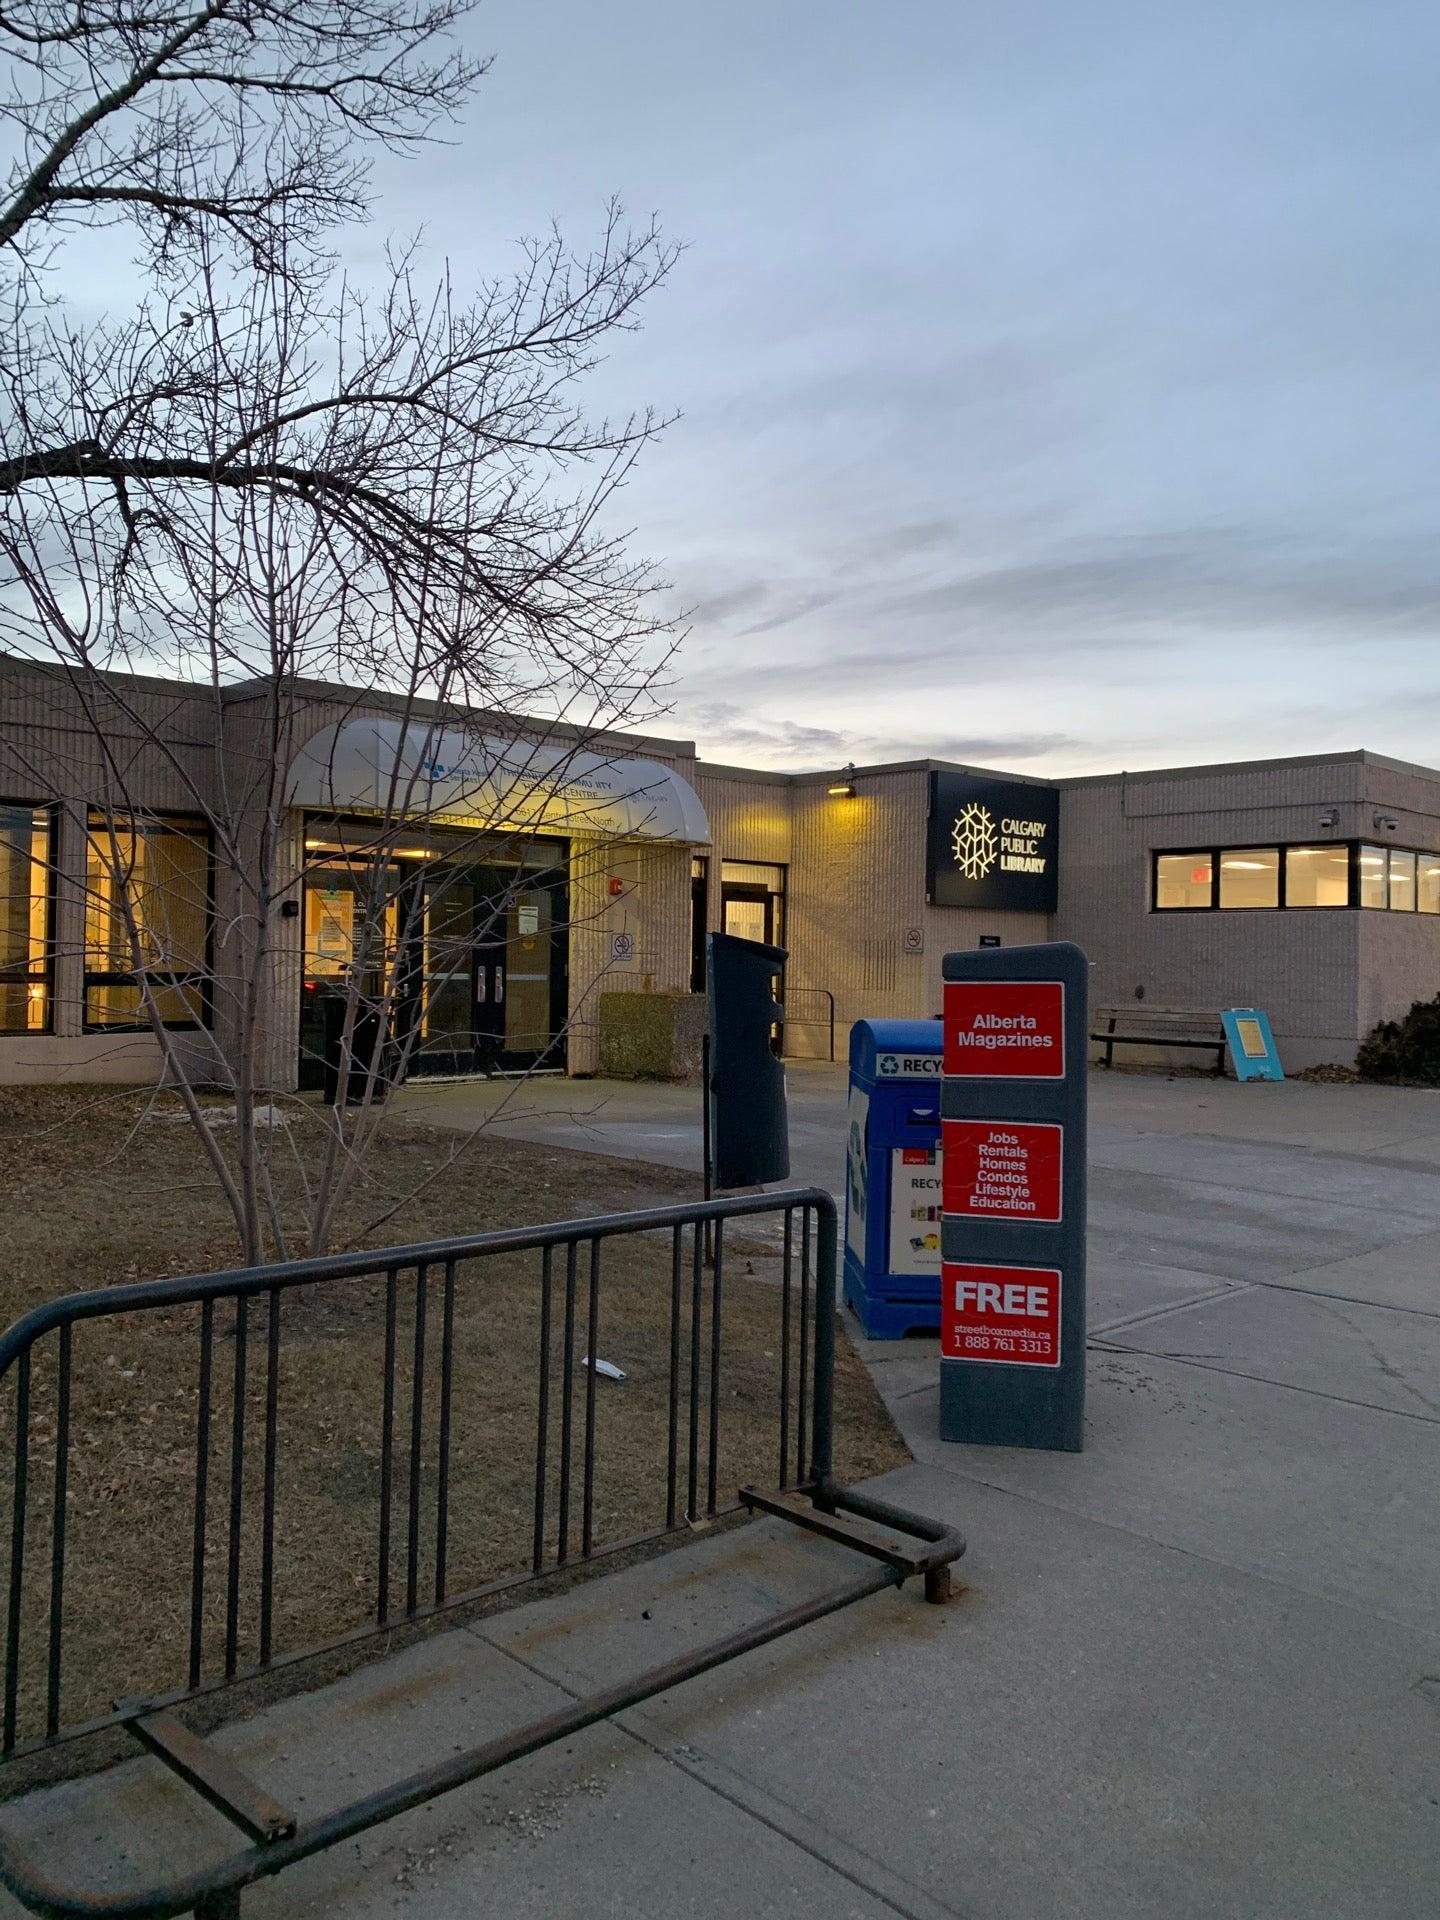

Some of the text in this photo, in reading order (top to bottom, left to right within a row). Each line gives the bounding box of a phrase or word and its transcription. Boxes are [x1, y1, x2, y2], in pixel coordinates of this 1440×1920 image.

[565, 787, 598, 799] CENTRE
[542, 809, 567, 821] Centr
[569, 814, 591, 825] Stree
[593, 816, 615, 827] North
[1001, 818, 1046, 837] CALGARY
[1001, 837, 1038, 855] PUBLIC
[1000, 855, 1046, 873] LIBRARY
[973, 1014, 1037, 1029] Alberta
[958, 1031, 1053, 1049] Magazines
[903, 1059, 944, 1072] RECY
[988, 1132, 1018, 1145] Jobs
[978, 1144, 1028, 1158] Rentals
[980, 1157, 1026, 1171] Homes
[911, 1178, 943, 1189] RECY
[977, 1170, 1028, 1184] Condos
[975, 1183, 1030, 1199] Lifestyle
[969, 1195, 1036, 1211] Education
[955, 1280, 1049, 1318] FREE
[954, 1324, 1051, 1340] streetboxmedia.ca
[954, 1335, 1051, 1354] 1 888 761 3313
